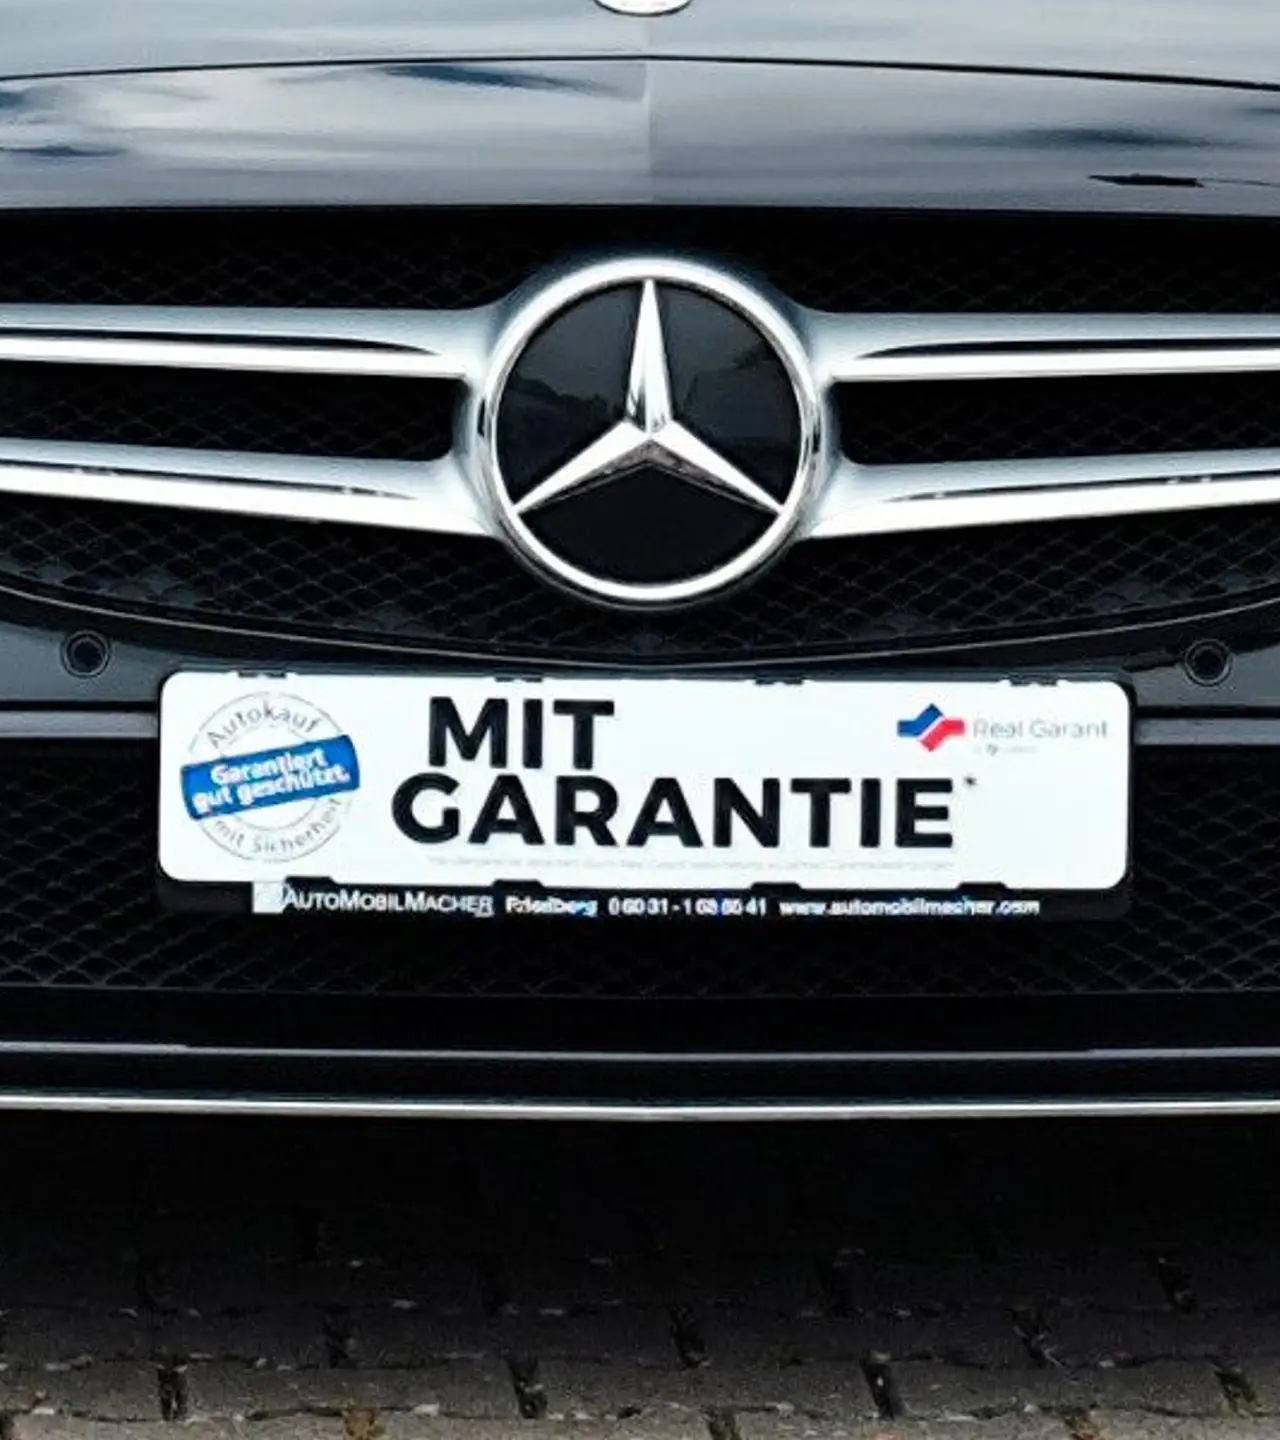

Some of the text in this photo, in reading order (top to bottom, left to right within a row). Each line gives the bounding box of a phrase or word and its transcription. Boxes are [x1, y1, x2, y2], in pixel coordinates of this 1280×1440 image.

[206, 700, 322, 750] Autokauf
[427, 696, 615, 771] MIT
[972, 718, 1107, 739] Real Garant
[210, 746, 329, 785] Garantiert
[191, 785, 234, 814] gut
[214, 818, 246, 848] mit
